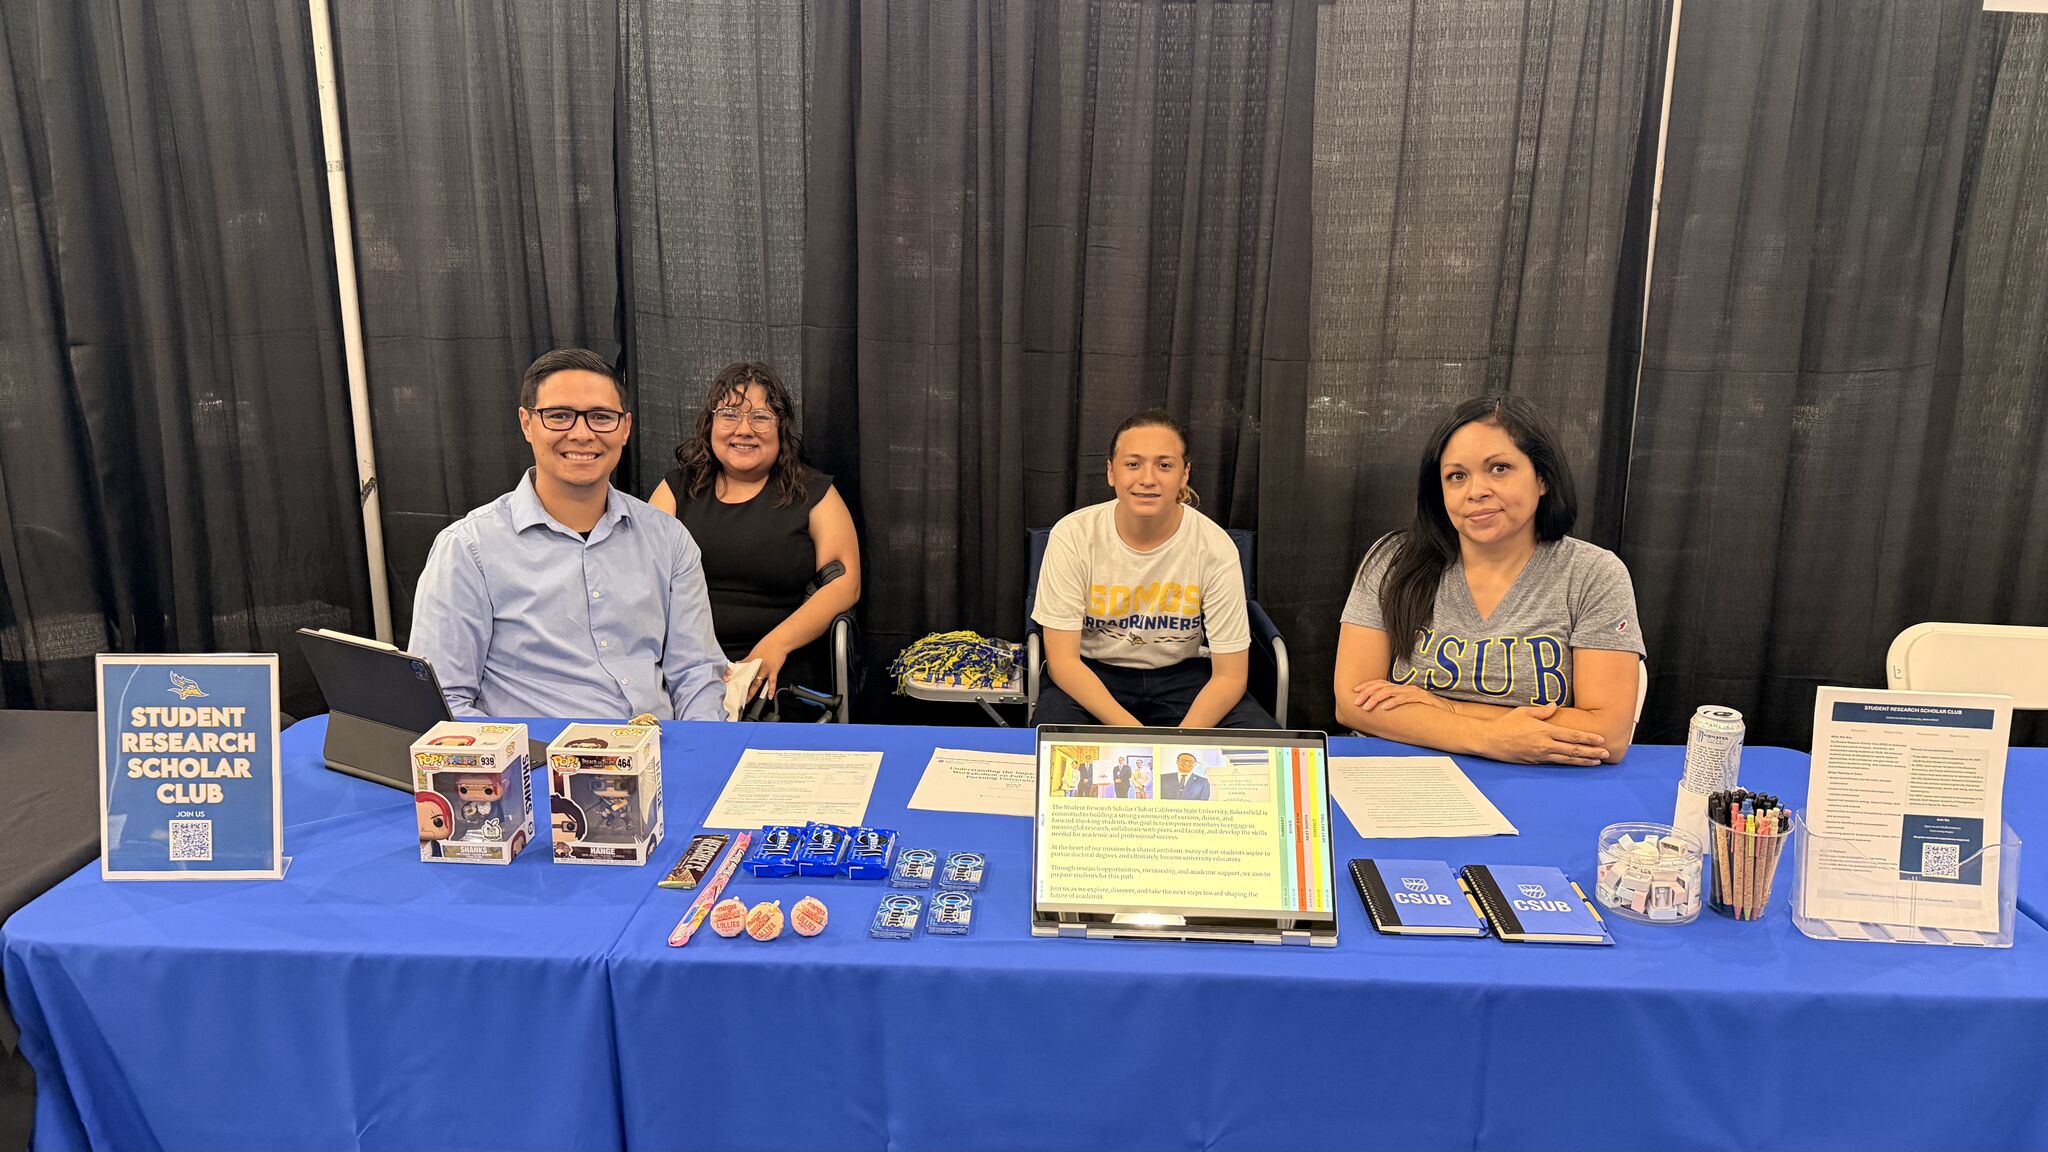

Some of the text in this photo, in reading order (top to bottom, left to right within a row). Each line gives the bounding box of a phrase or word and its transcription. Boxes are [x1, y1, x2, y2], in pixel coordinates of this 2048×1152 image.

[1388, 626, 1568, 707] CSUB
[130, 706, 245, 728] STUDENT
[122, 732, 256, 753] RESEARCH
[127, 758, 252, 778] SCHOLAR
[415, 753, 444, 766] POP!
[480, 757, 495, 765] 939
[551, 755, 579, 768] POP!
[618, 758, 631, 768] 464
[156, 783, 224, 804] CLUB
[520, 755, 533, 816] SHANKS
[778, 830, 788, 849] OREO
[822, 830, 833, 848] OREO
[868, 832, 878, 850] OREO
[684, 838, 722, 872] HERSHEY'S
[904, 850, 934, 877] Orbit
[952, 854, 982, 881] Orbit
[937, 892, 969, 923] Orbit
[1394, 892, 1452, 905] CSUB
[1513, 900, 1571, 912] CSUB
[886, 896, 918, 928] Orbit
[756, 923, 776, 938] LOLLIES
[797, 914, 816, 932] LOLLIES
